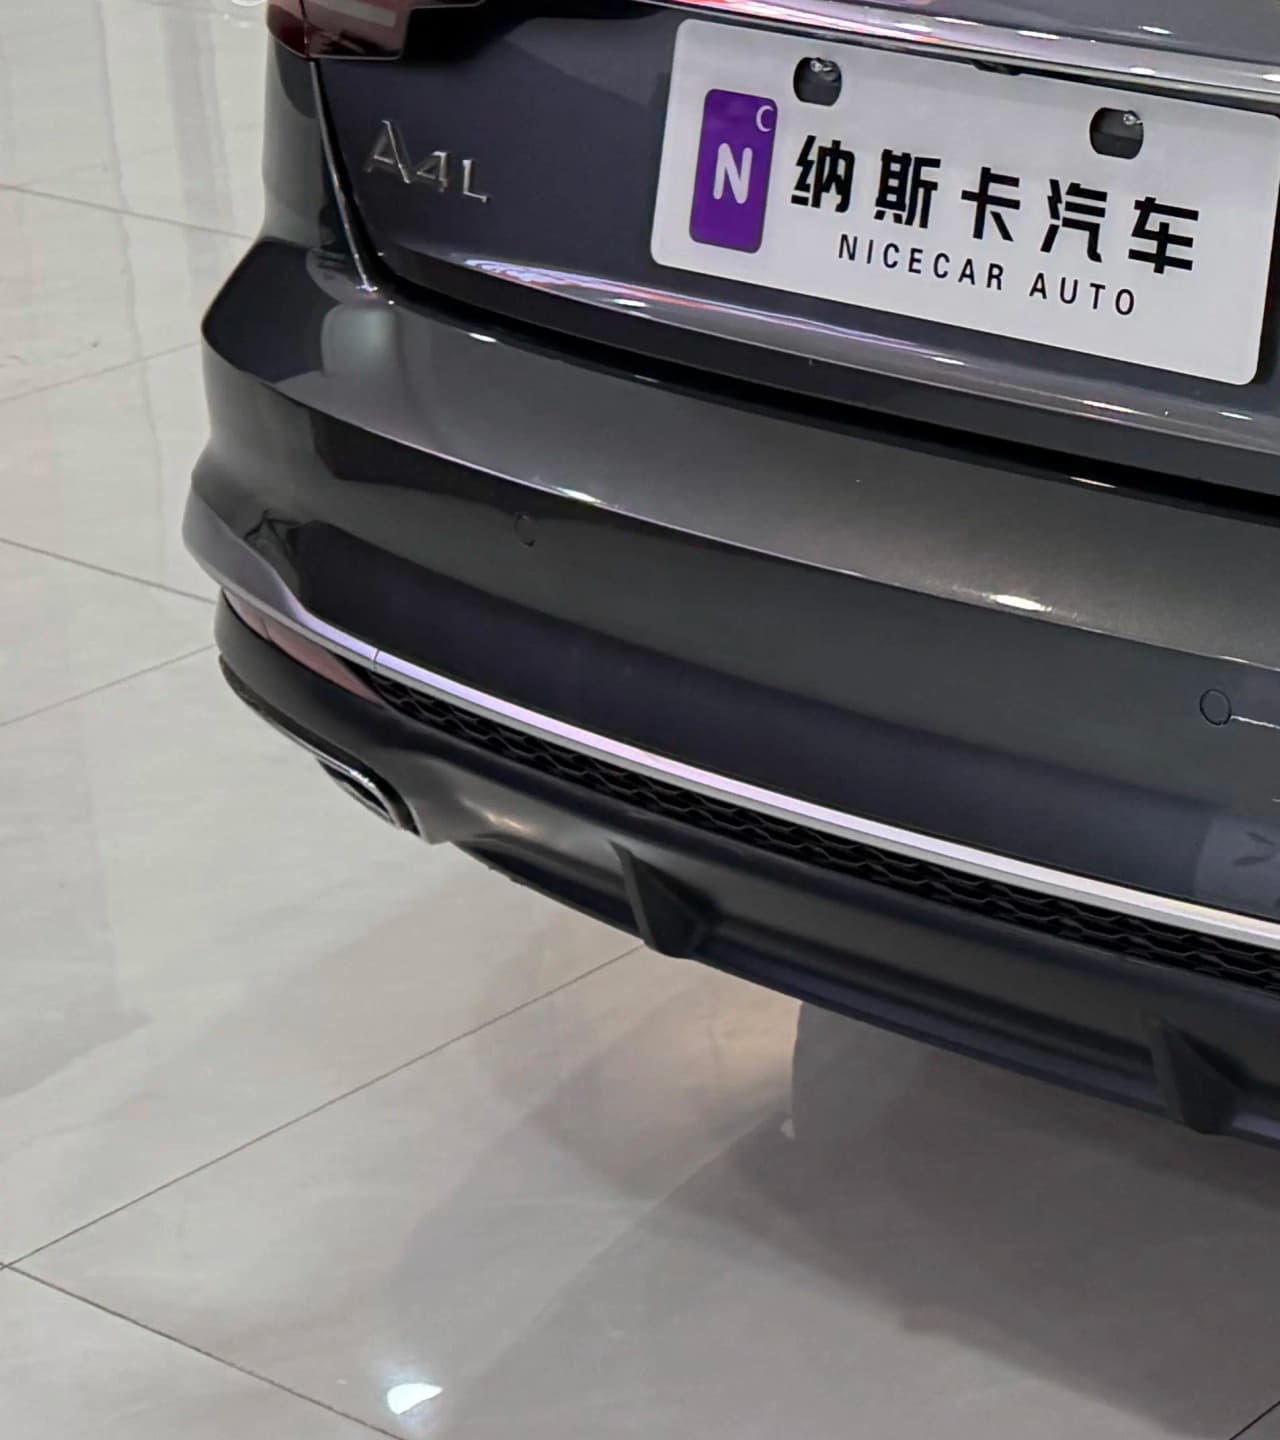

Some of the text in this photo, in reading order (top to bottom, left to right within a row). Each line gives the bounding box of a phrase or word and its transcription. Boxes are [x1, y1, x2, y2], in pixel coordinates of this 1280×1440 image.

[362, 119, 490, 203] A4L
[712, 141, 754, 206] N
[790, 133, 1200, 275] 纳斯卡汽车
[838, 233, 1136, 316] NICECAR AUTO
